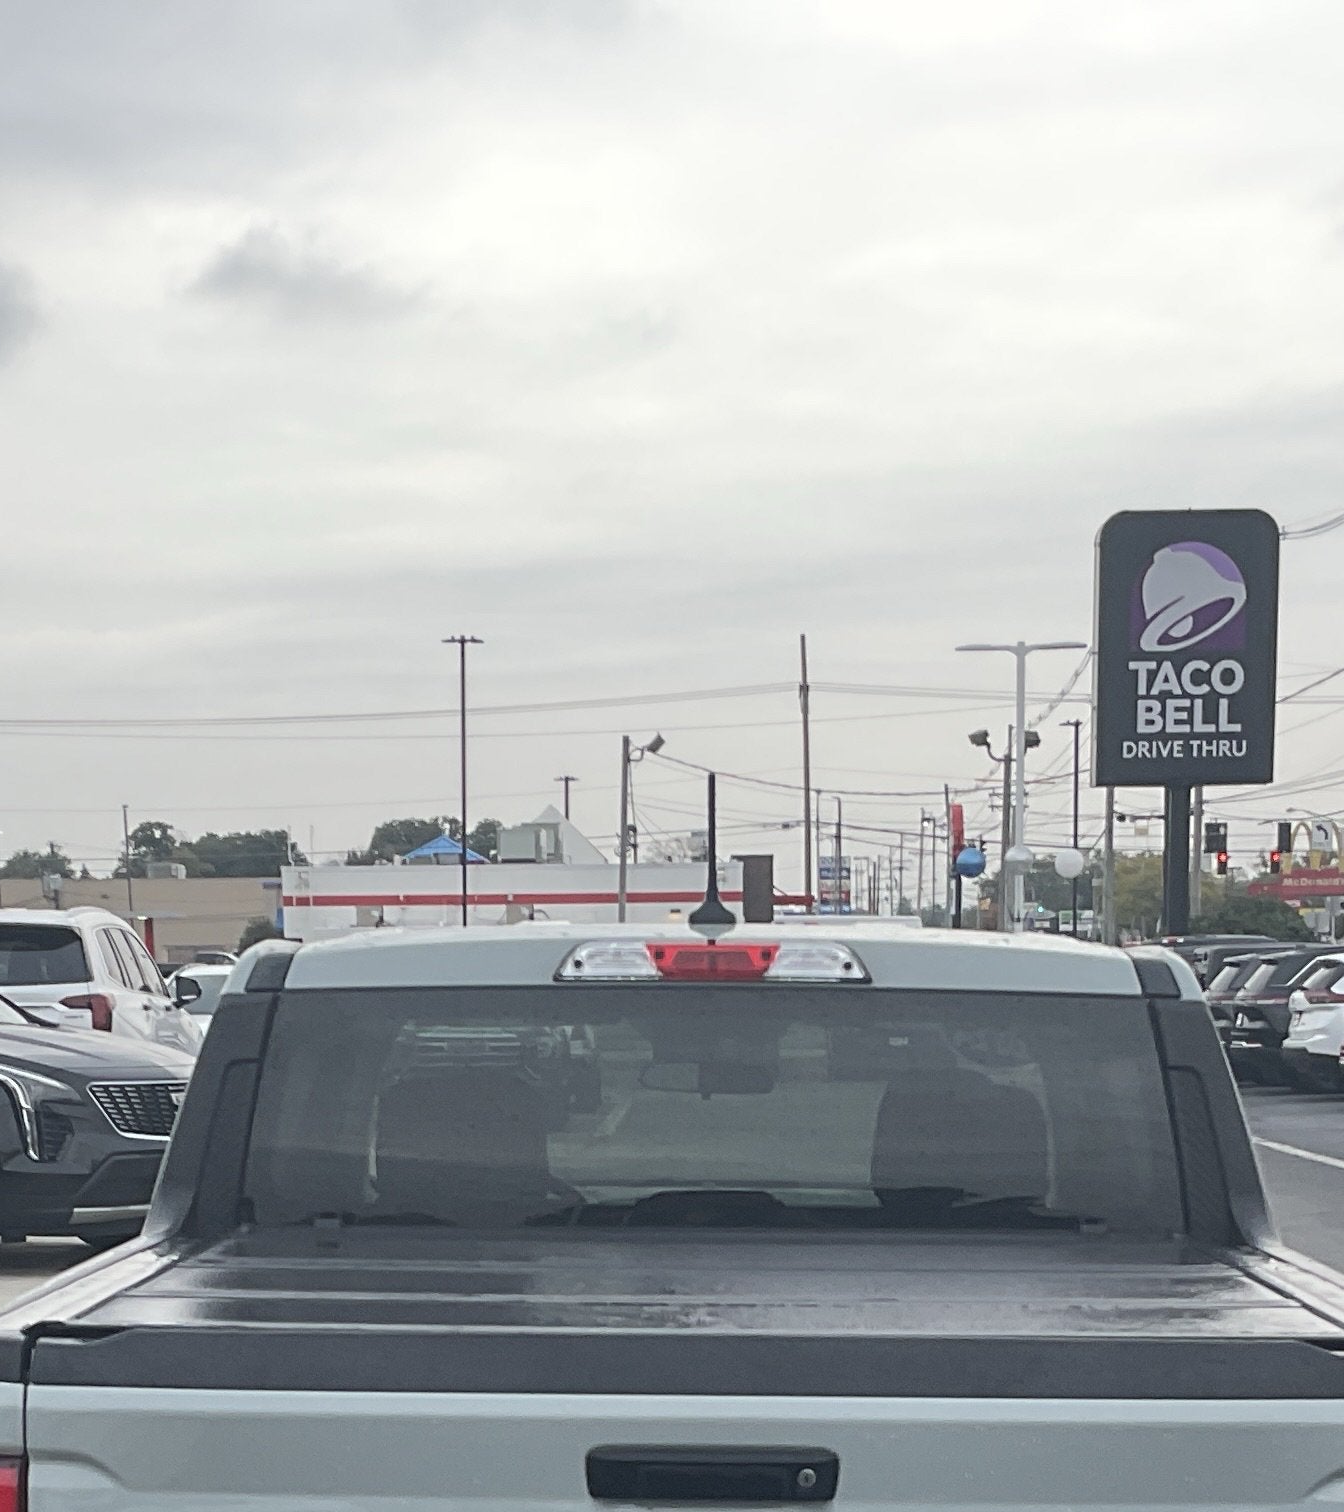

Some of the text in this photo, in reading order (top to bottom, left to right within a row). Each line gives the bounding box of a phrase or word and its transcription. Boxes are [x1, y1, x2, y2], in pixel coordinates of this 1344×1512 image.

[1127, 659, 1245, 696] TACO
[1136, 698, 1242, 734] BELL
[1121, 739, 1247, 759] DRIVE THRU
